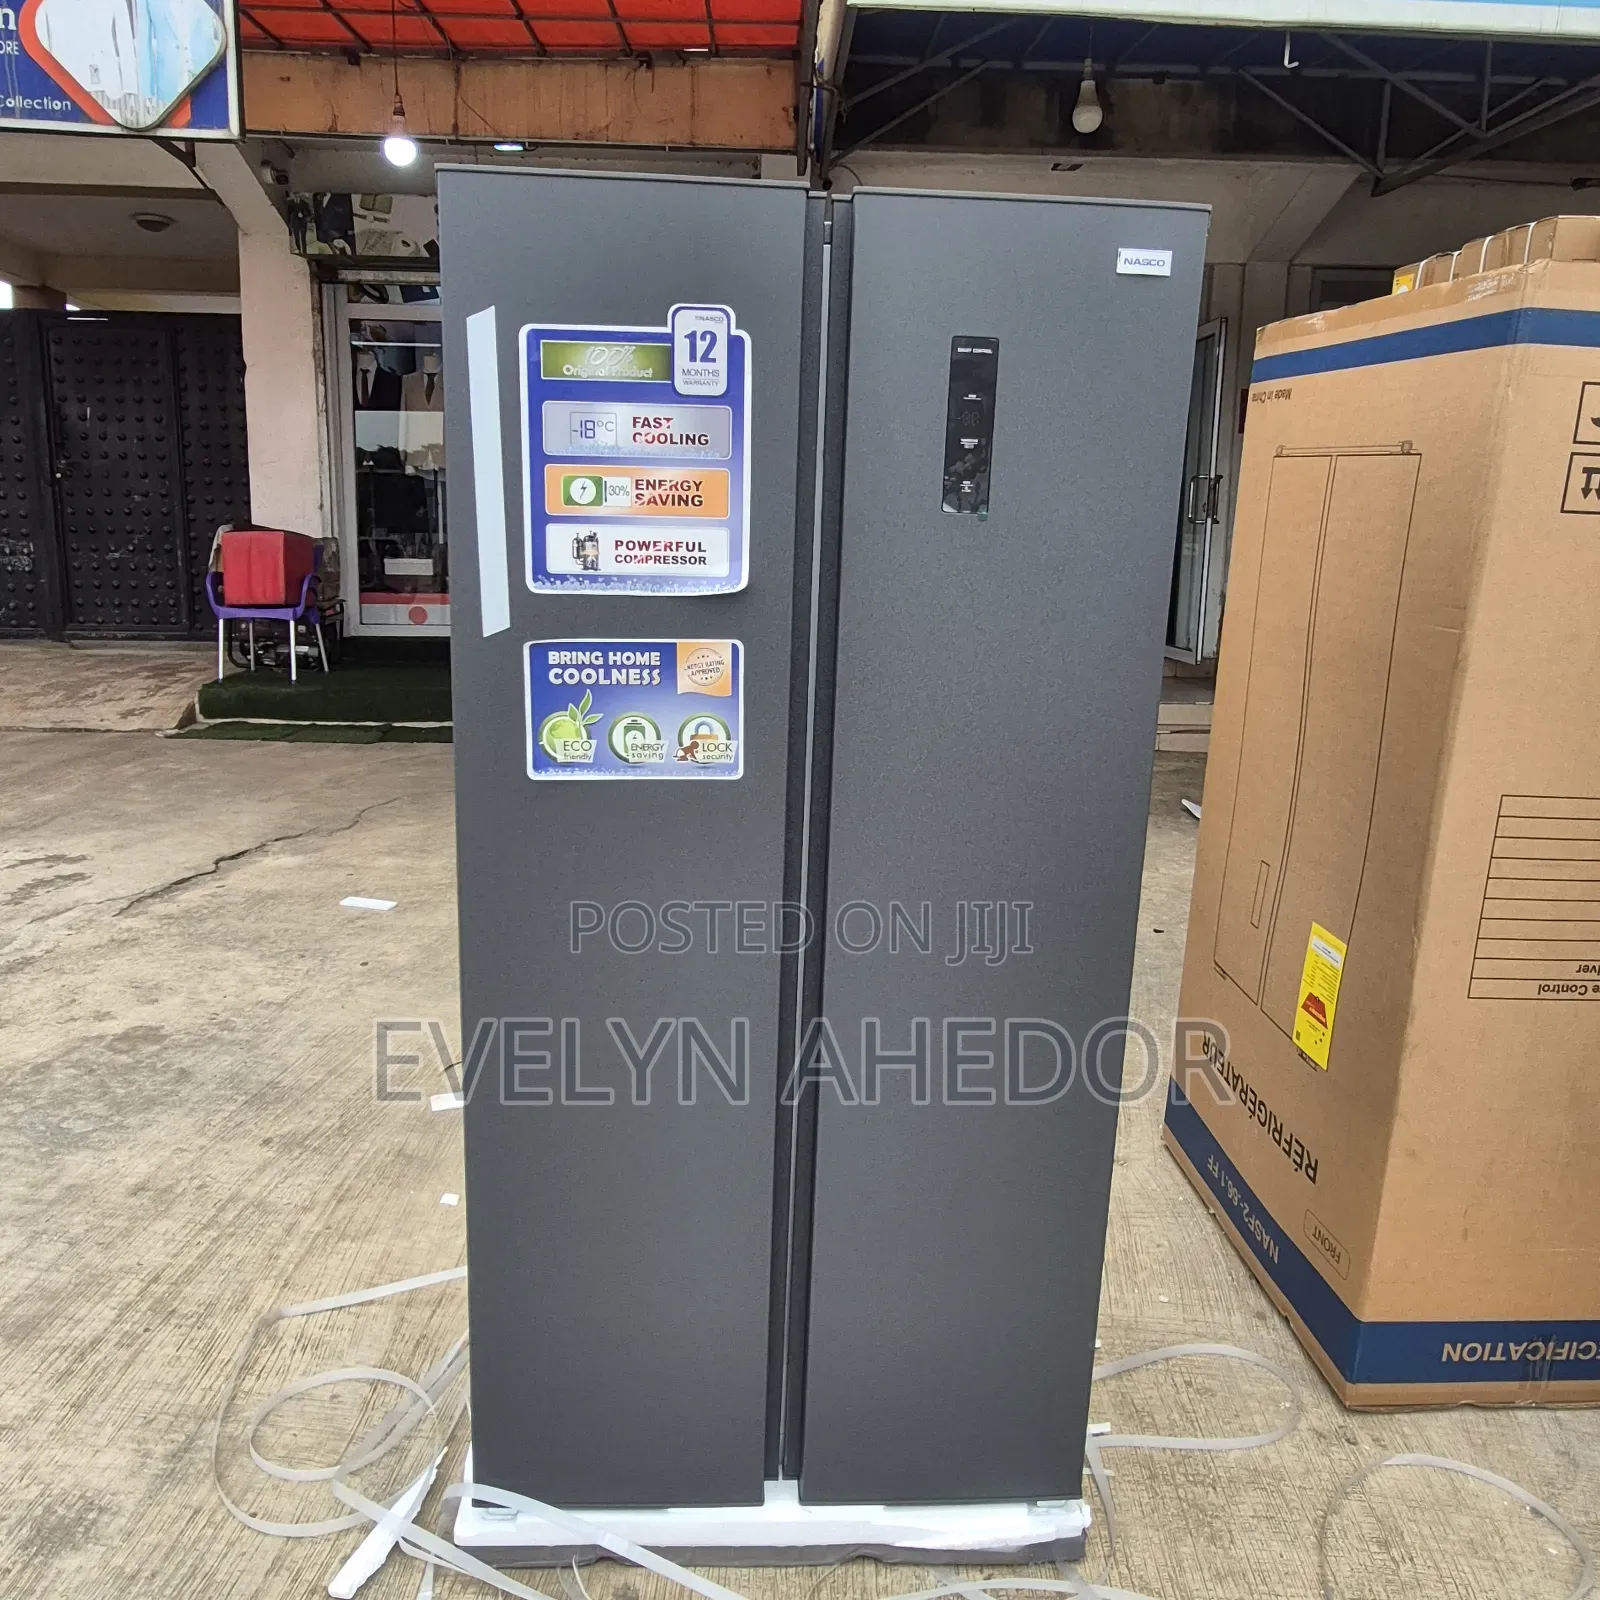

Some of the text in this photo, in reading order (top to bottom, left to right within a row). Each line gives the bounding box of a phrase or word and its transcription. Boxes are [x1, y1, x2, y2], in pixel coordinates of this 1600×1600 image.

[1124, 258, 1165, 267] NASCO
[684, 330, 718, 363] 12
[585, 345, 636, 366] 100%
[562, 364, 653, 378] Original Product
[682, 369, 720, 377] MONTHS
[683, 379, 719, 387] WARRANTY
[632, 416, 673, 429] FAST
[632, 432, 709, 446] COOLING
[608, 485, 630, 497] 30%
[635, 479, 703, 492] ENERGY
[635, 493, 703, 507] SAVING
[615, 540, 707, 553] POWERFUL
[615, 554, 707, 566] COMPRESSOR
[548, 651, 661, 666] BRING HOME
[549, 668, 661, 686] COOLNESS
[563, 741, 592, 751] ECO
[702, 742, 733, 752] LOCK
[563, 753, 592, 762] friendly
[631, 752, 664, 761] saving
[702, 753, 734, 762] security
[1537, 984, 1588, 996] Control
[1202, 1030, 1319, 1185] RÉFRIGÉRATEUR
[1312, 1225, 1341, 1264] FRONT
